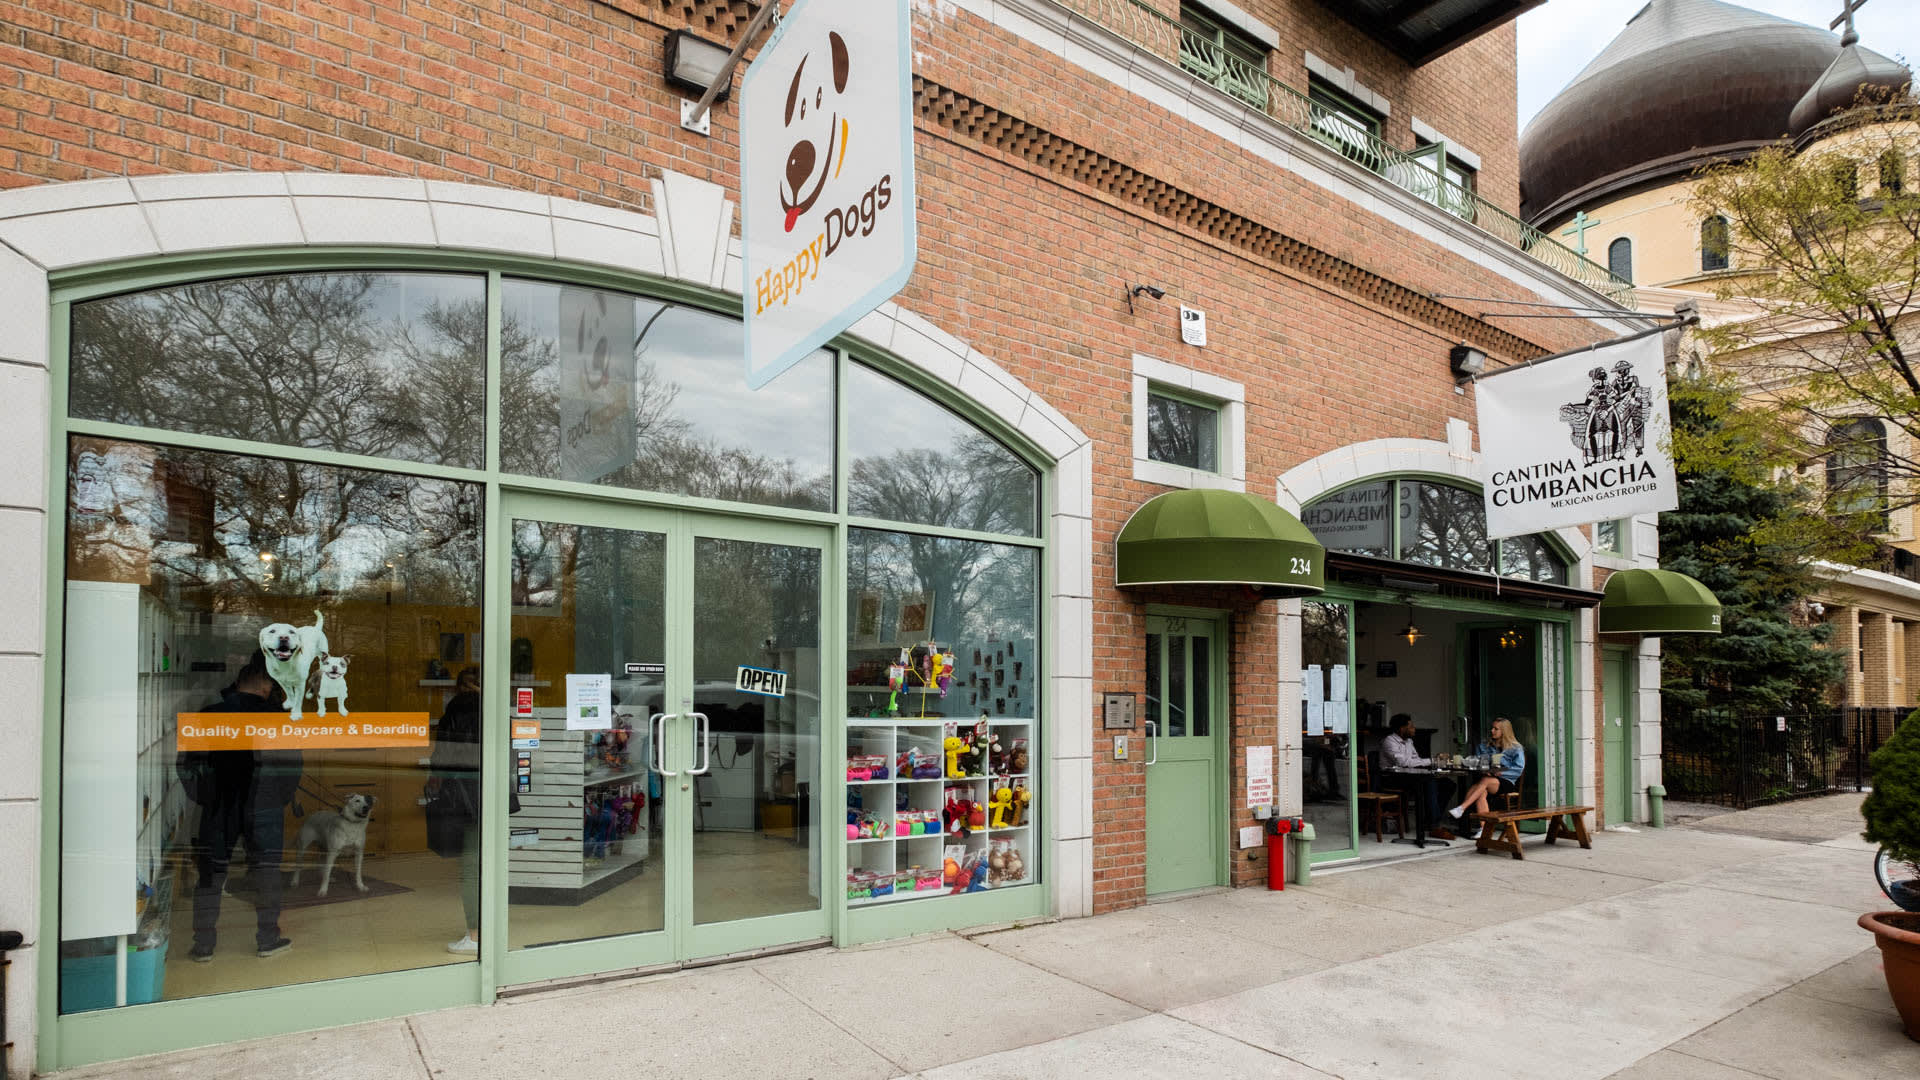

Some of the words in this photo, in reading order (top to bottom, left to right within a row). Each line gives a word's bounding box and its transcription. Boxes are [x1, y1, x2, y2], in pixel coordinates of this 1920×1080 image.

[1492, 458, 1577, 487] CANTINA
[1492, 460, 1657, 507] CUMBANCHA
[1550, 495, 1594, 509] MEXICAN
[1596, 482, 1657, 501] GASTROPUB
[1290, 557, 1311, 576] 234
[739, 667, 785, 694] OPEN
[181, 725, 240, 739] Quality
[245, 725, 277, 738] Dog
[282, 724, 343, 738] Daycare
[347, 724, 359, 735] &
[363, 723, 427, 736] Boarding
